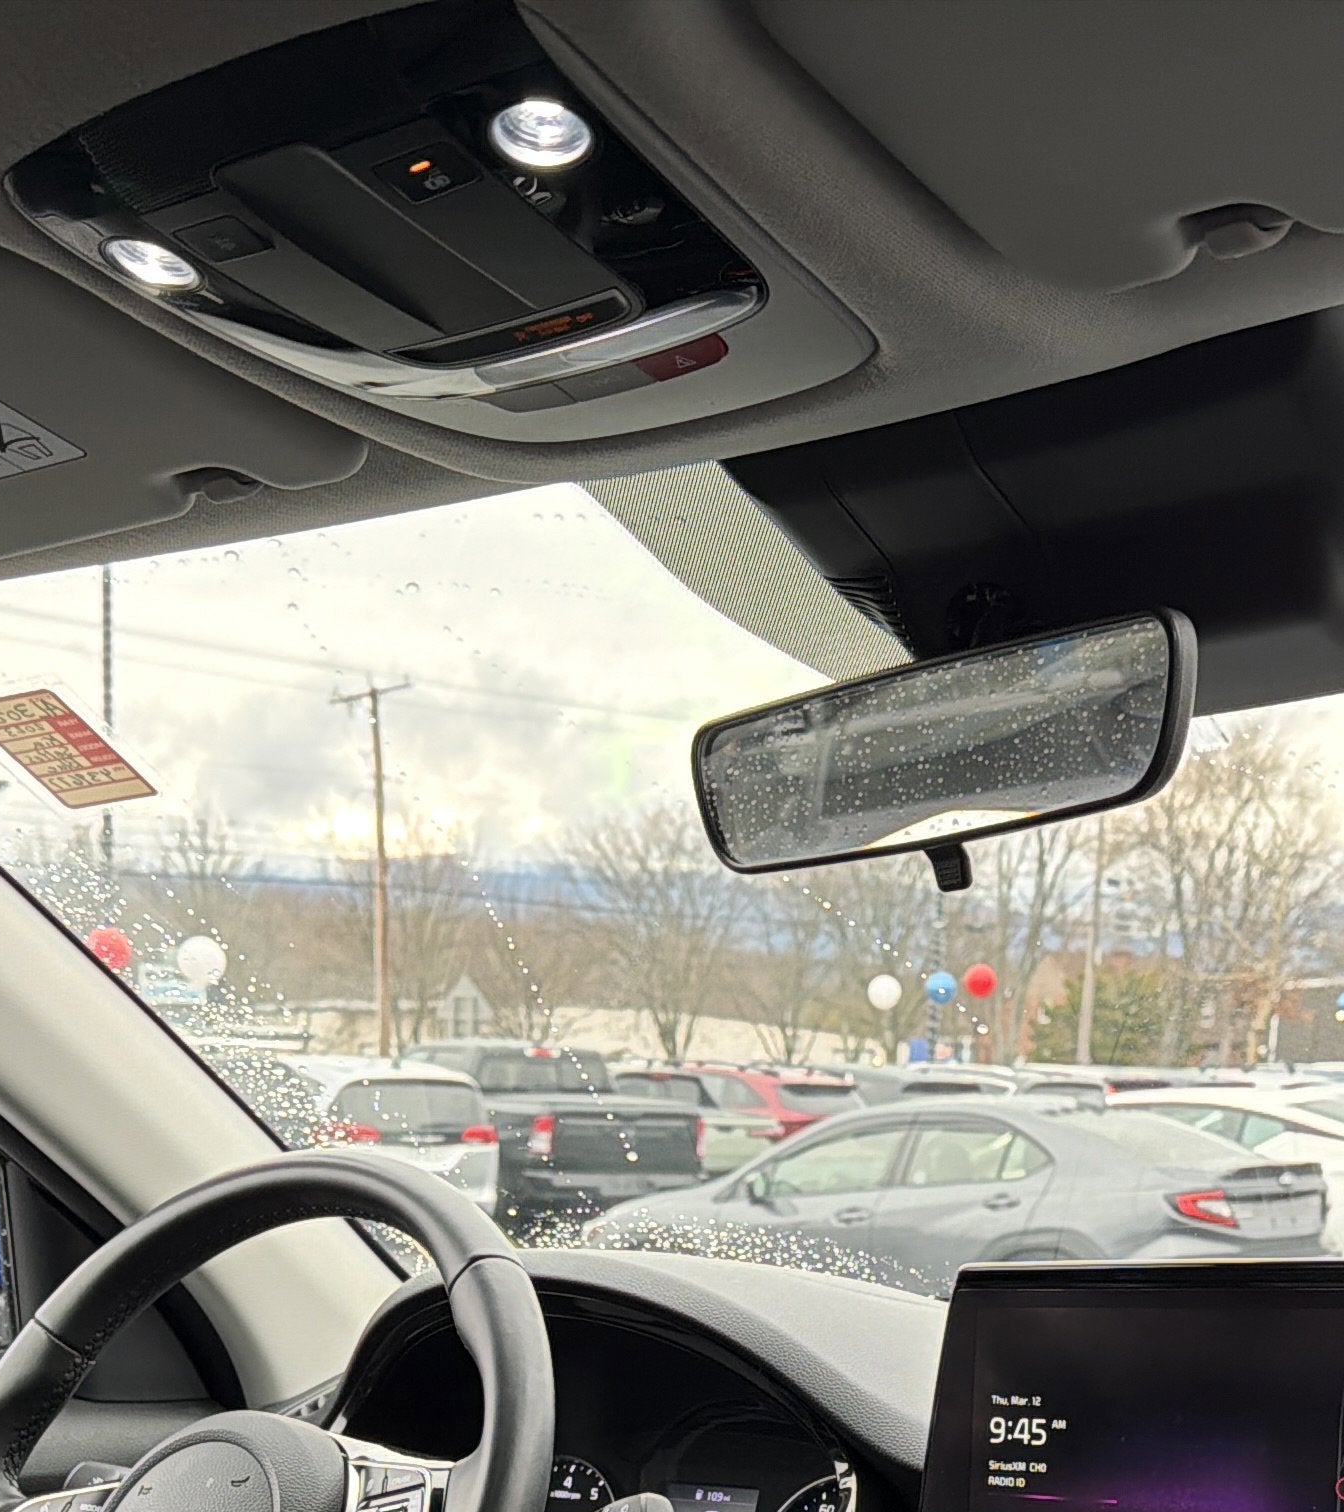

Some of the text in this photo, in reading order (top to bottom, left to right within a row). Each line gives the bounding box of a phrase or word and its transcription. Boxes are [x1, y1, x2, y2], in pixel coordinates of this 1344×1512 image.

[1032, 1396, 1042, 1406] 12
[989, 1416, 1067, 1446] 9:45 AM
[988, 1460, 1027, 1472] SiriusXM
[563, 1475, 573, 1490] 4
[988, 1476, 1026, 1488] RADIO ID
[590, 1487, 599, 1501] 5
